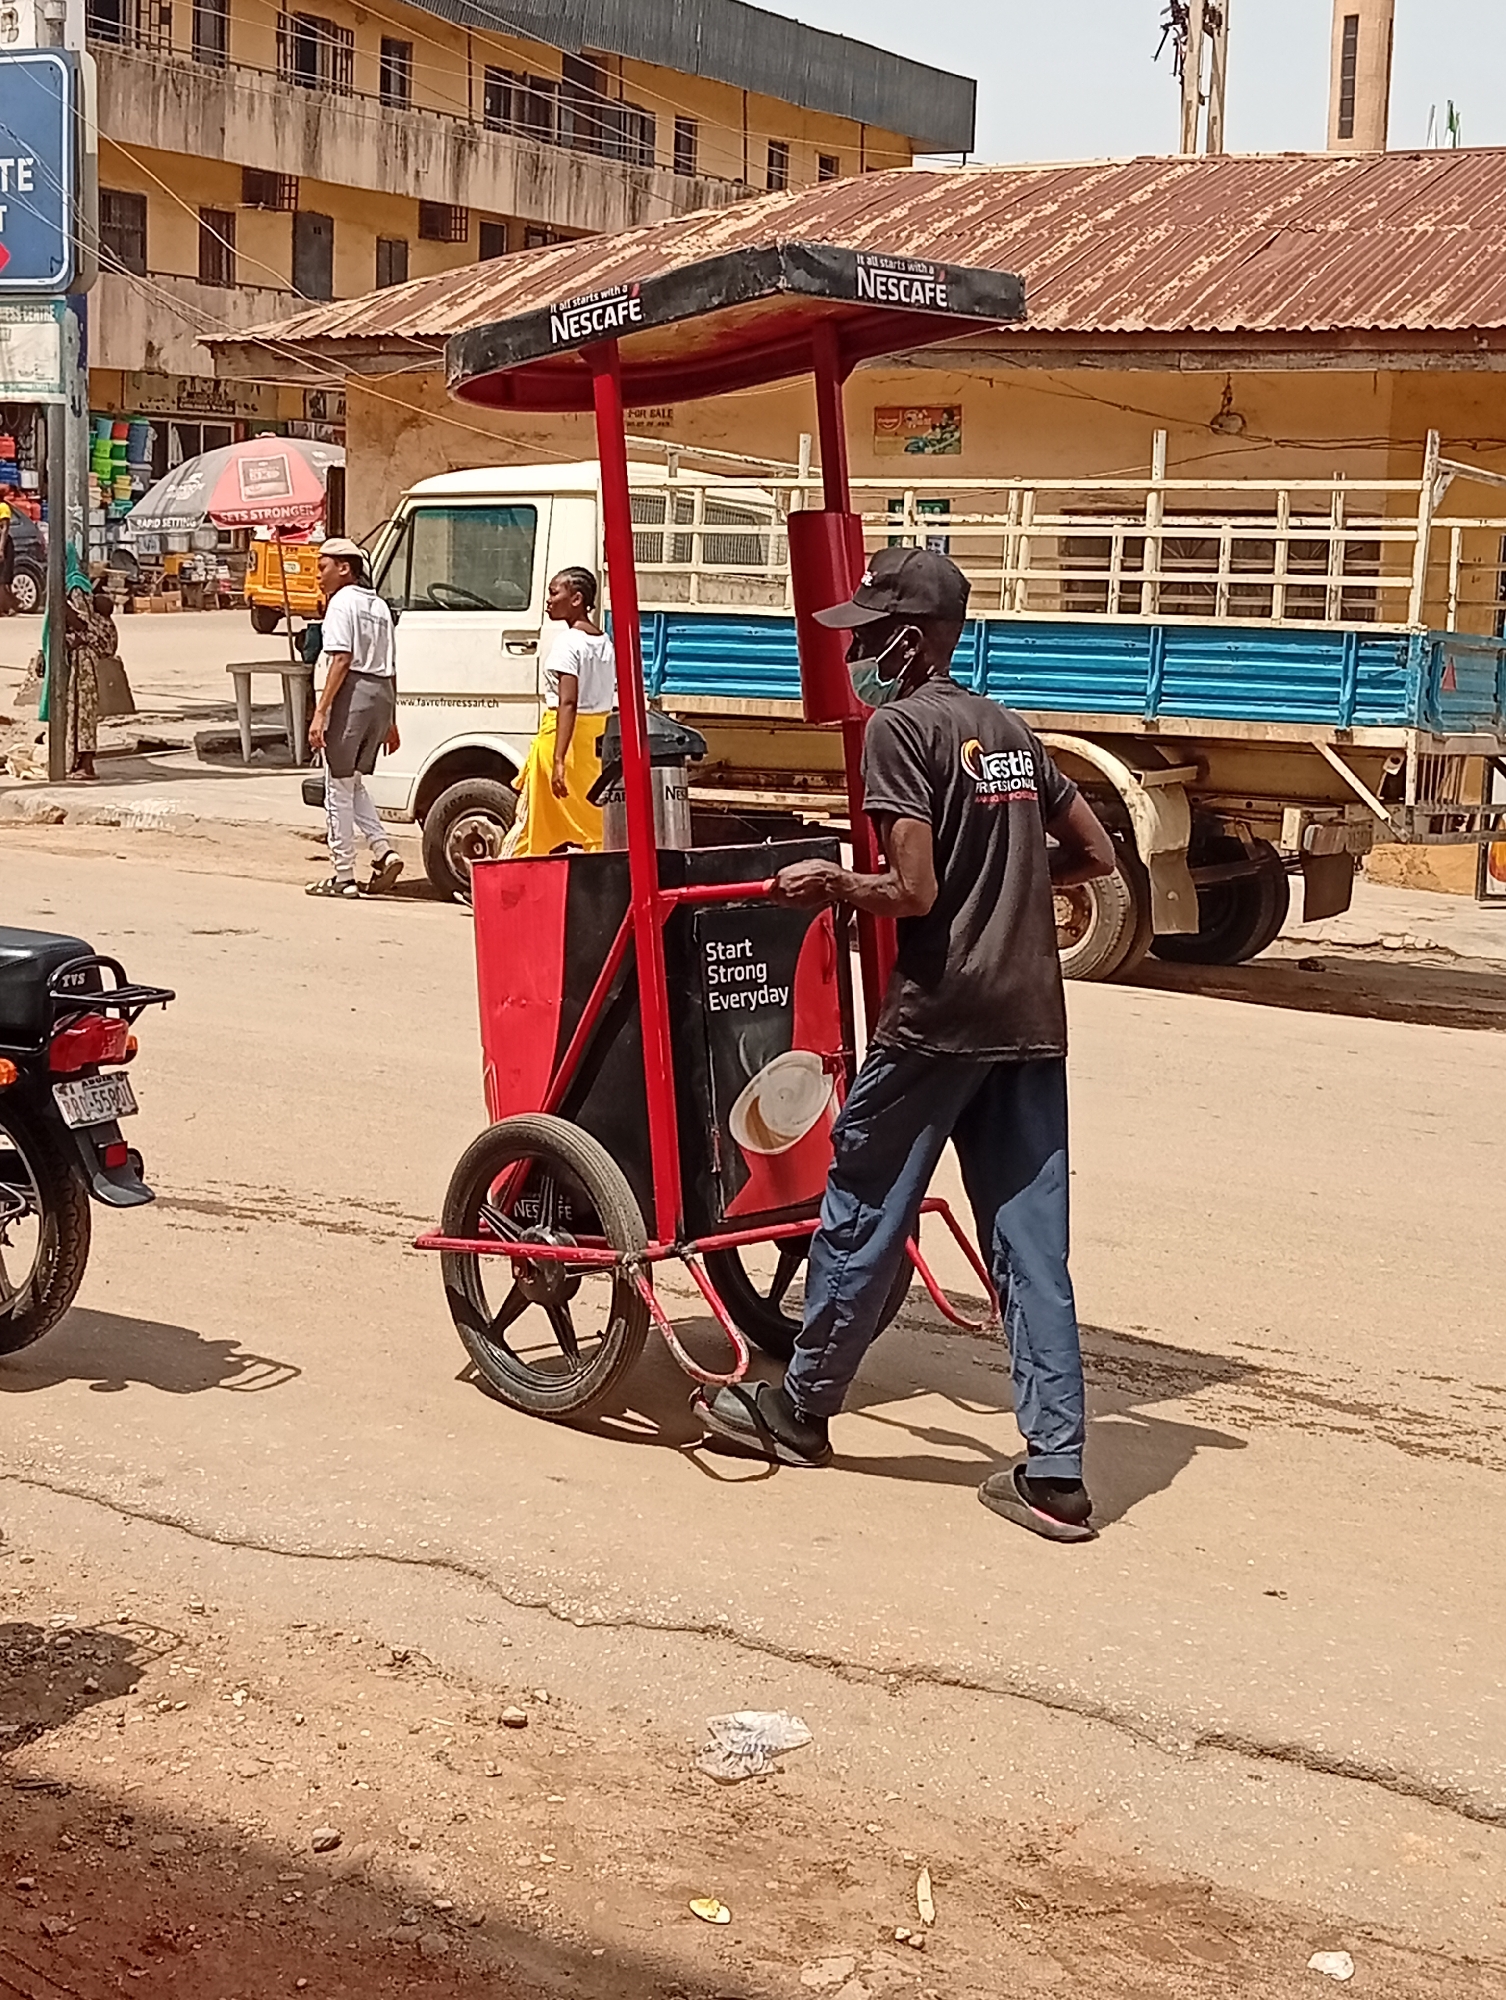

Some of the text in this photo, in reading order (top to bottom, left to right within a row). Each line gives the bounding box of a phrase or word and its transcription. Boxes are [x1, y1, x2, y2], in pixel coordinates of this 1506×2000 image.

[880, 258, 906, 271] starts
[907, 262, 928, 273] with
[573, 293, 600, 307] starts
[600, 285, 621, 299] with
[162, 516, 197, 528] SETTING
[221, 504, 315, 522] SETS STRONGER
[705, 938, 753, 961] Start
[61, 973, 86, 988] TVS
[707, 963, 767, 985] Strong
[708, 984, 789, 1011] Everyday
[513, 1199, 573, 1220] NESFE
